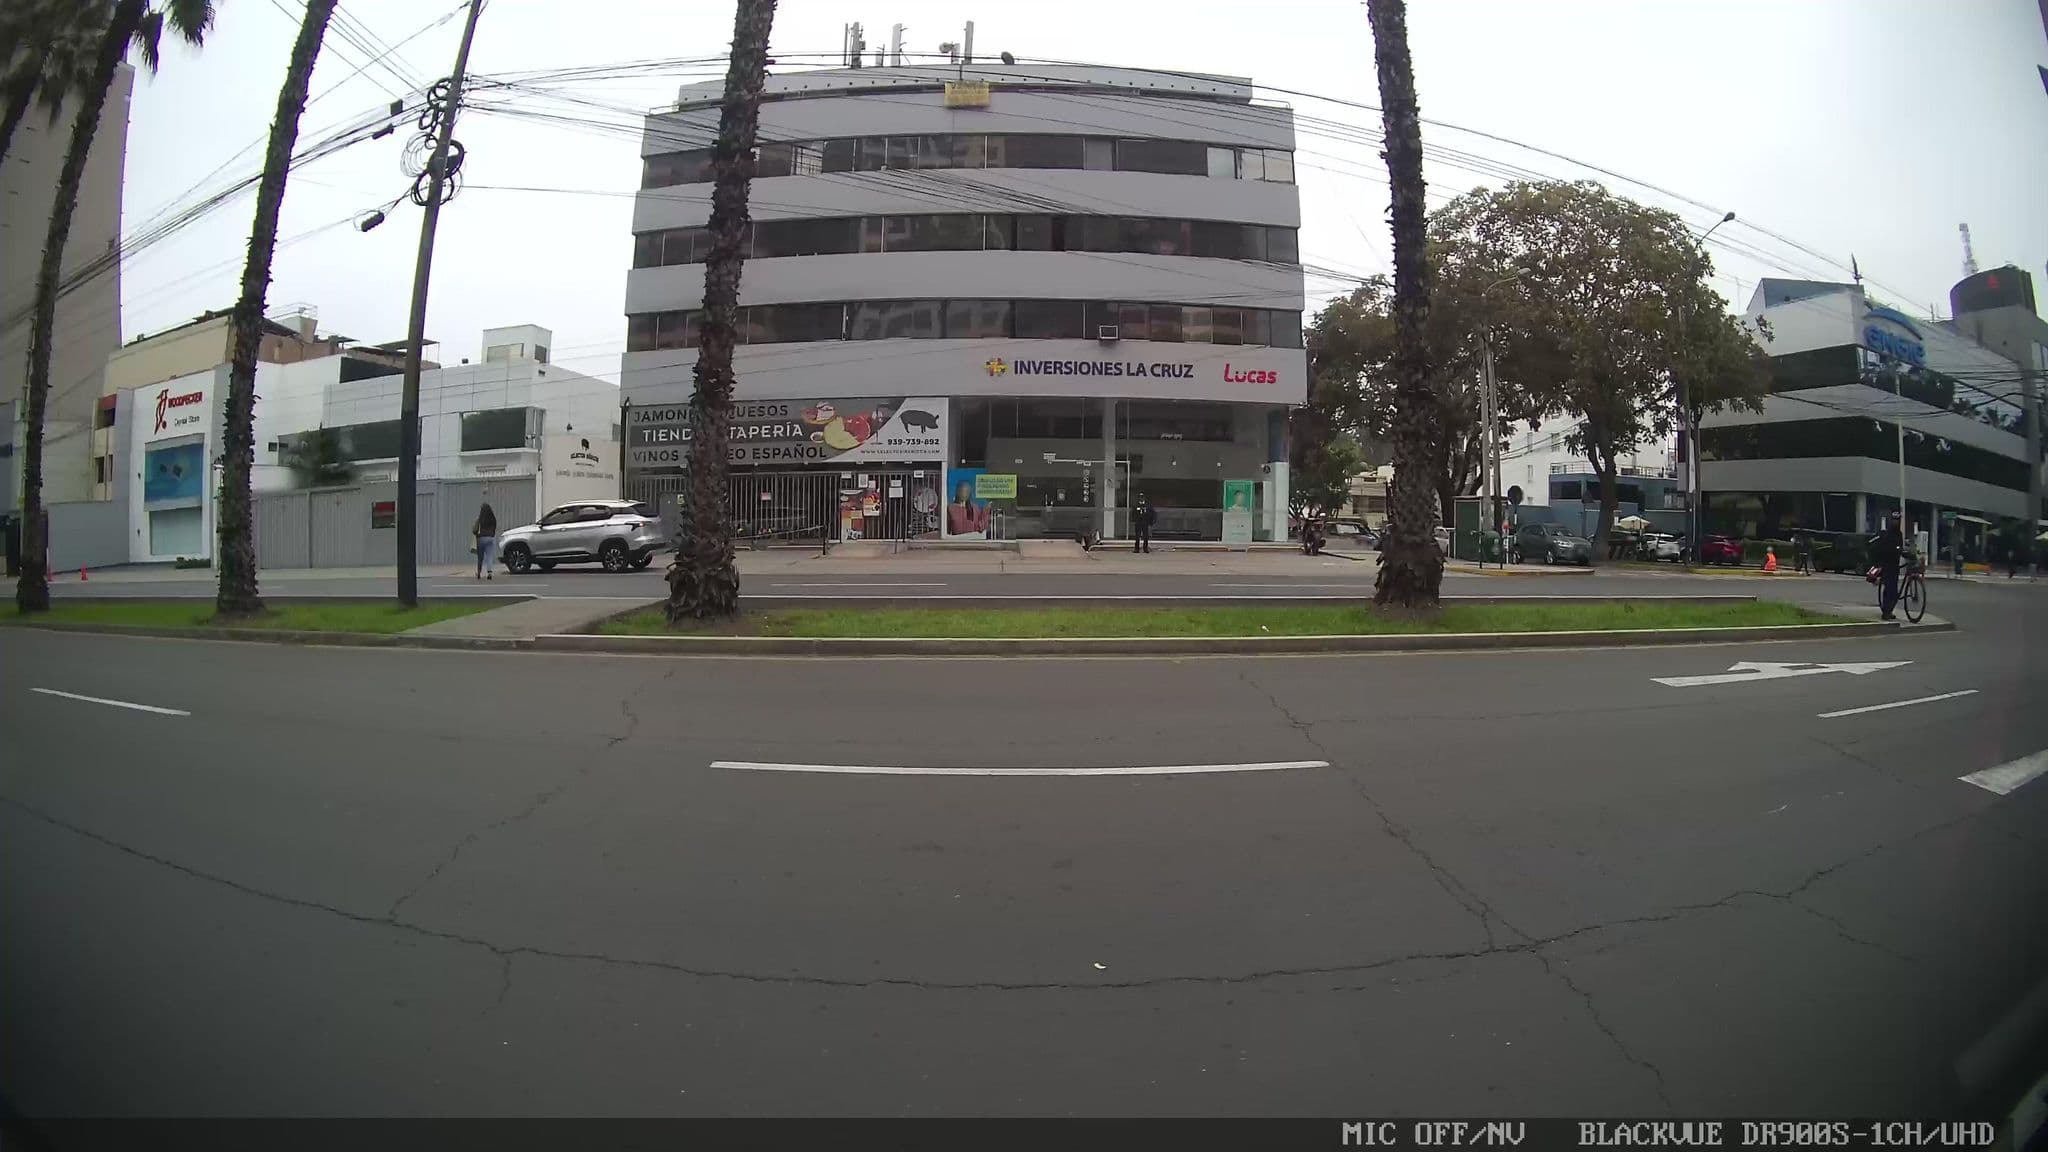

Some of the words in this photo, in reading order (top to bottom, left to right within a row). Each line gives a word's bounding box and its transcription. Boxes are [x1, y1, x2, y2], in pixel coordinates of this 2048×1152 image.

[1014, 360, 1123, 377] INVERSIONES
[1126, 362, 1148, 377] LA
[1150, 363, 1194, 379] CRUZ
[1224, 363, 1277, 384] Lucas
[634, 408, 694, 423] JAMON
[643, 428, 693, 442] TIEND
[730, 421, 803, 439] TAPERÍA
[633, 449, 679, 463] VINOS
[752, 443, 827, 460] ESPAÑOL
